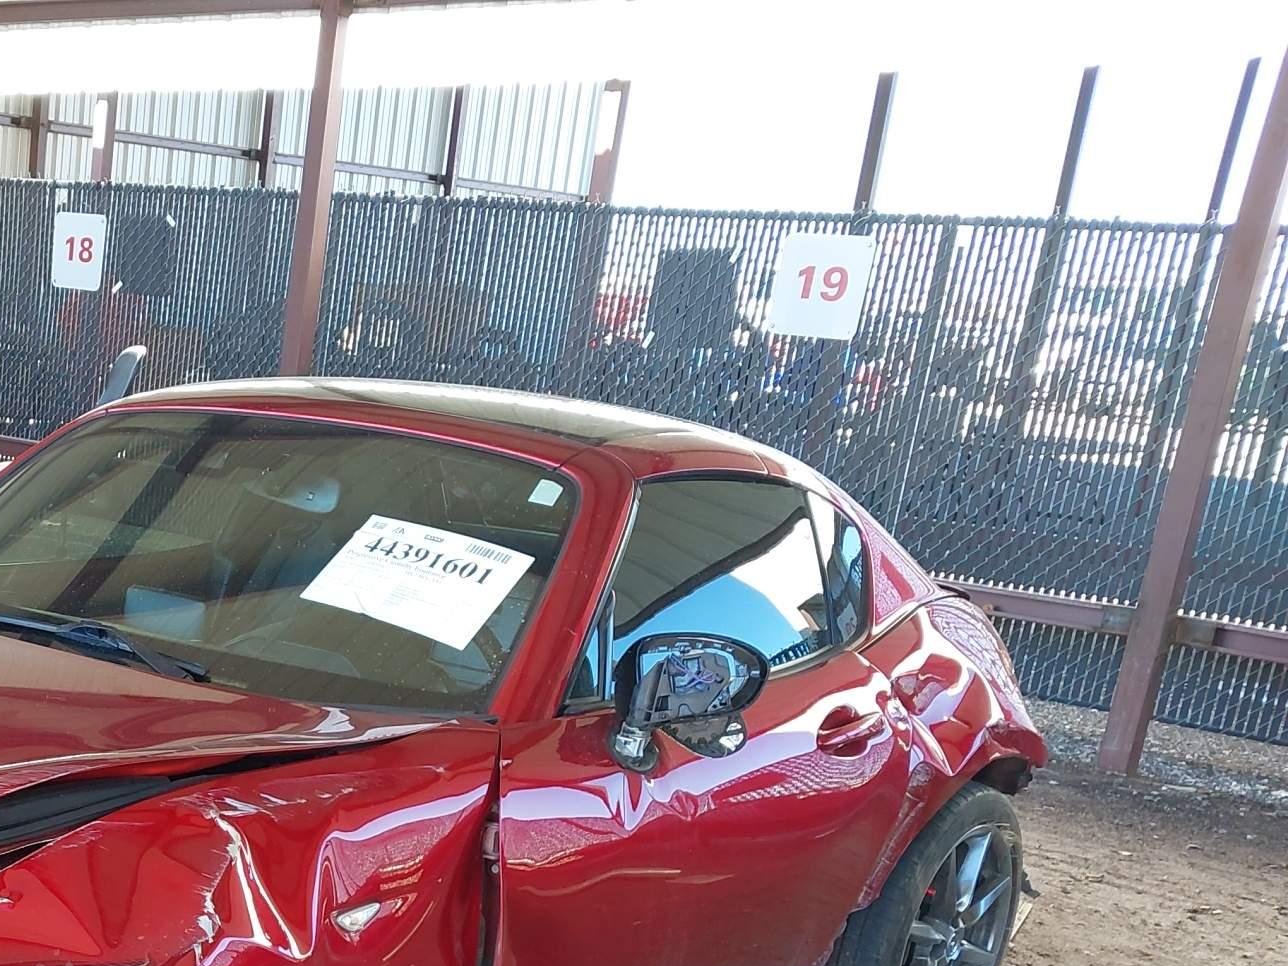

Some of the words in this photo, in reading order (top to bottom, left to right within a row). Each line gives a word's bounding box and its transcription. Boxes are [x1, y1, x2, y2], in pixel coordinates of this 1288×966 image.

[65, 236, 94, 263] 18
[798, 265, 849, 302] 19
[364, 536, 494, 585] 44391601
